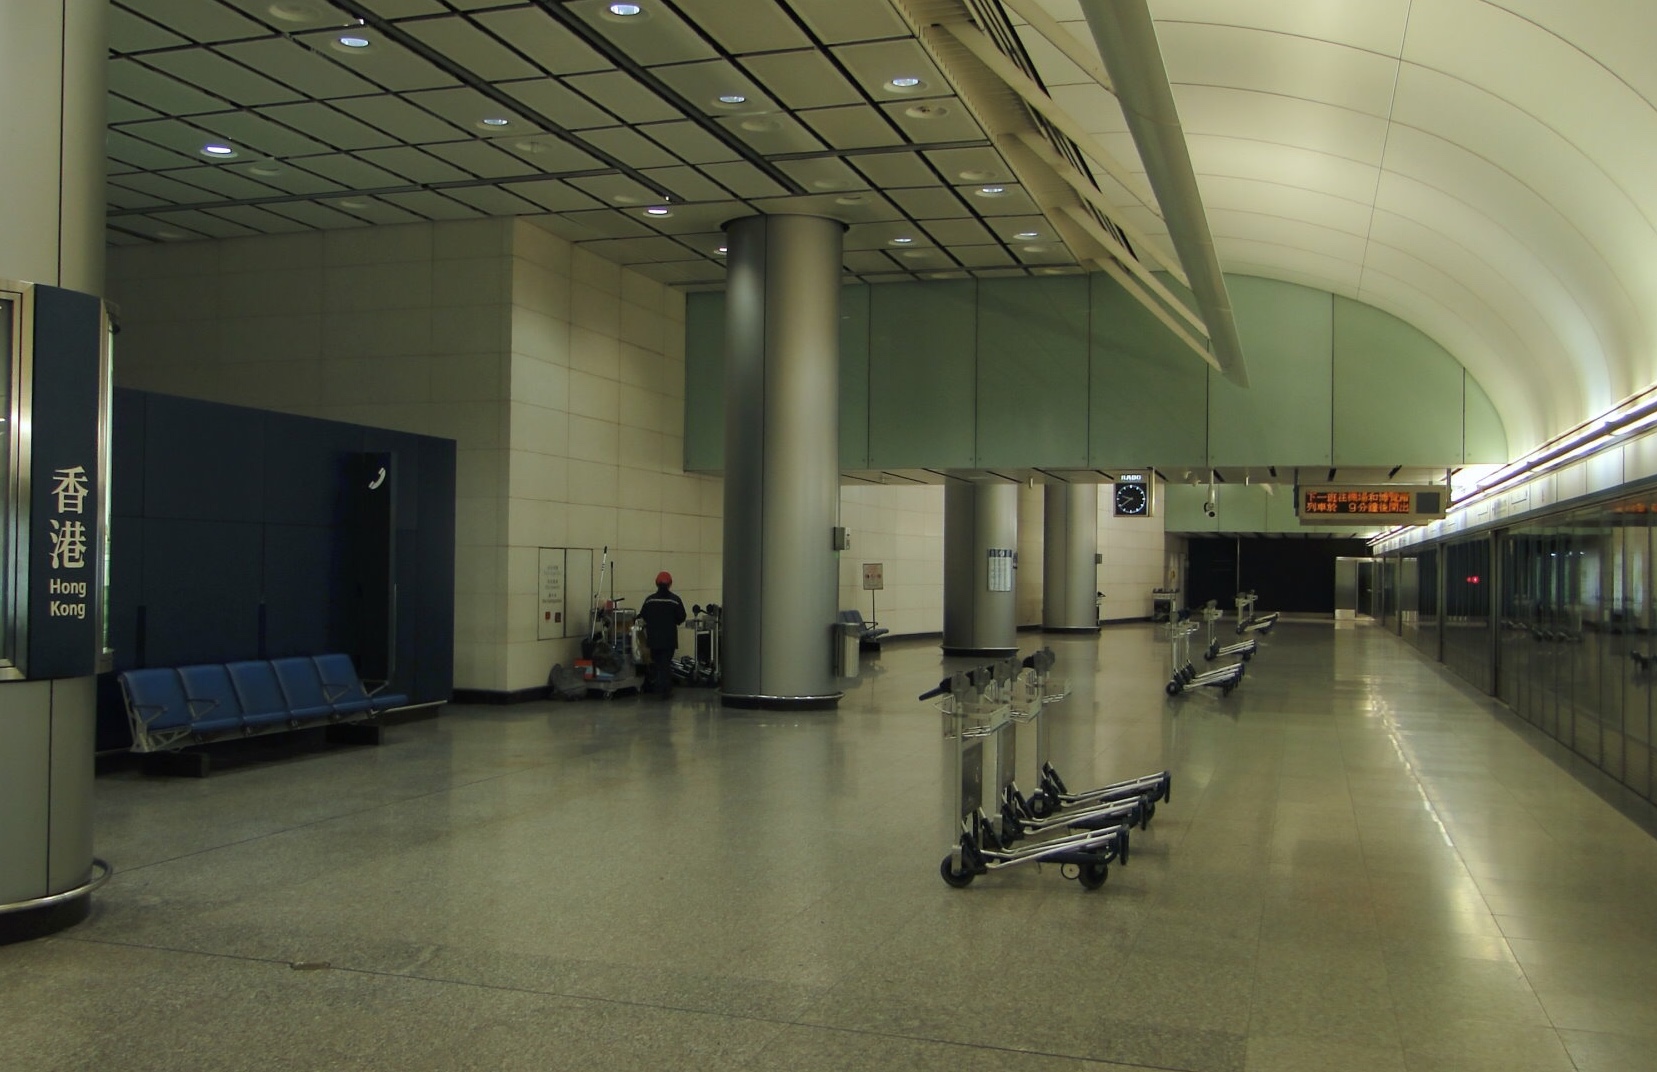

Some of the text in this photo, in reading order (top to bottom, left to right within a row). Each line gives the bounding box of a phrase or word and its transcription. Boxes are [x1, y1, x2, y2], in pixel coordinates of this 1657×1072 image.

[50, 465, 89, 569] 香港
[49, 578, 87, 597] Hong
[50, 601, 86, 619] Kong
